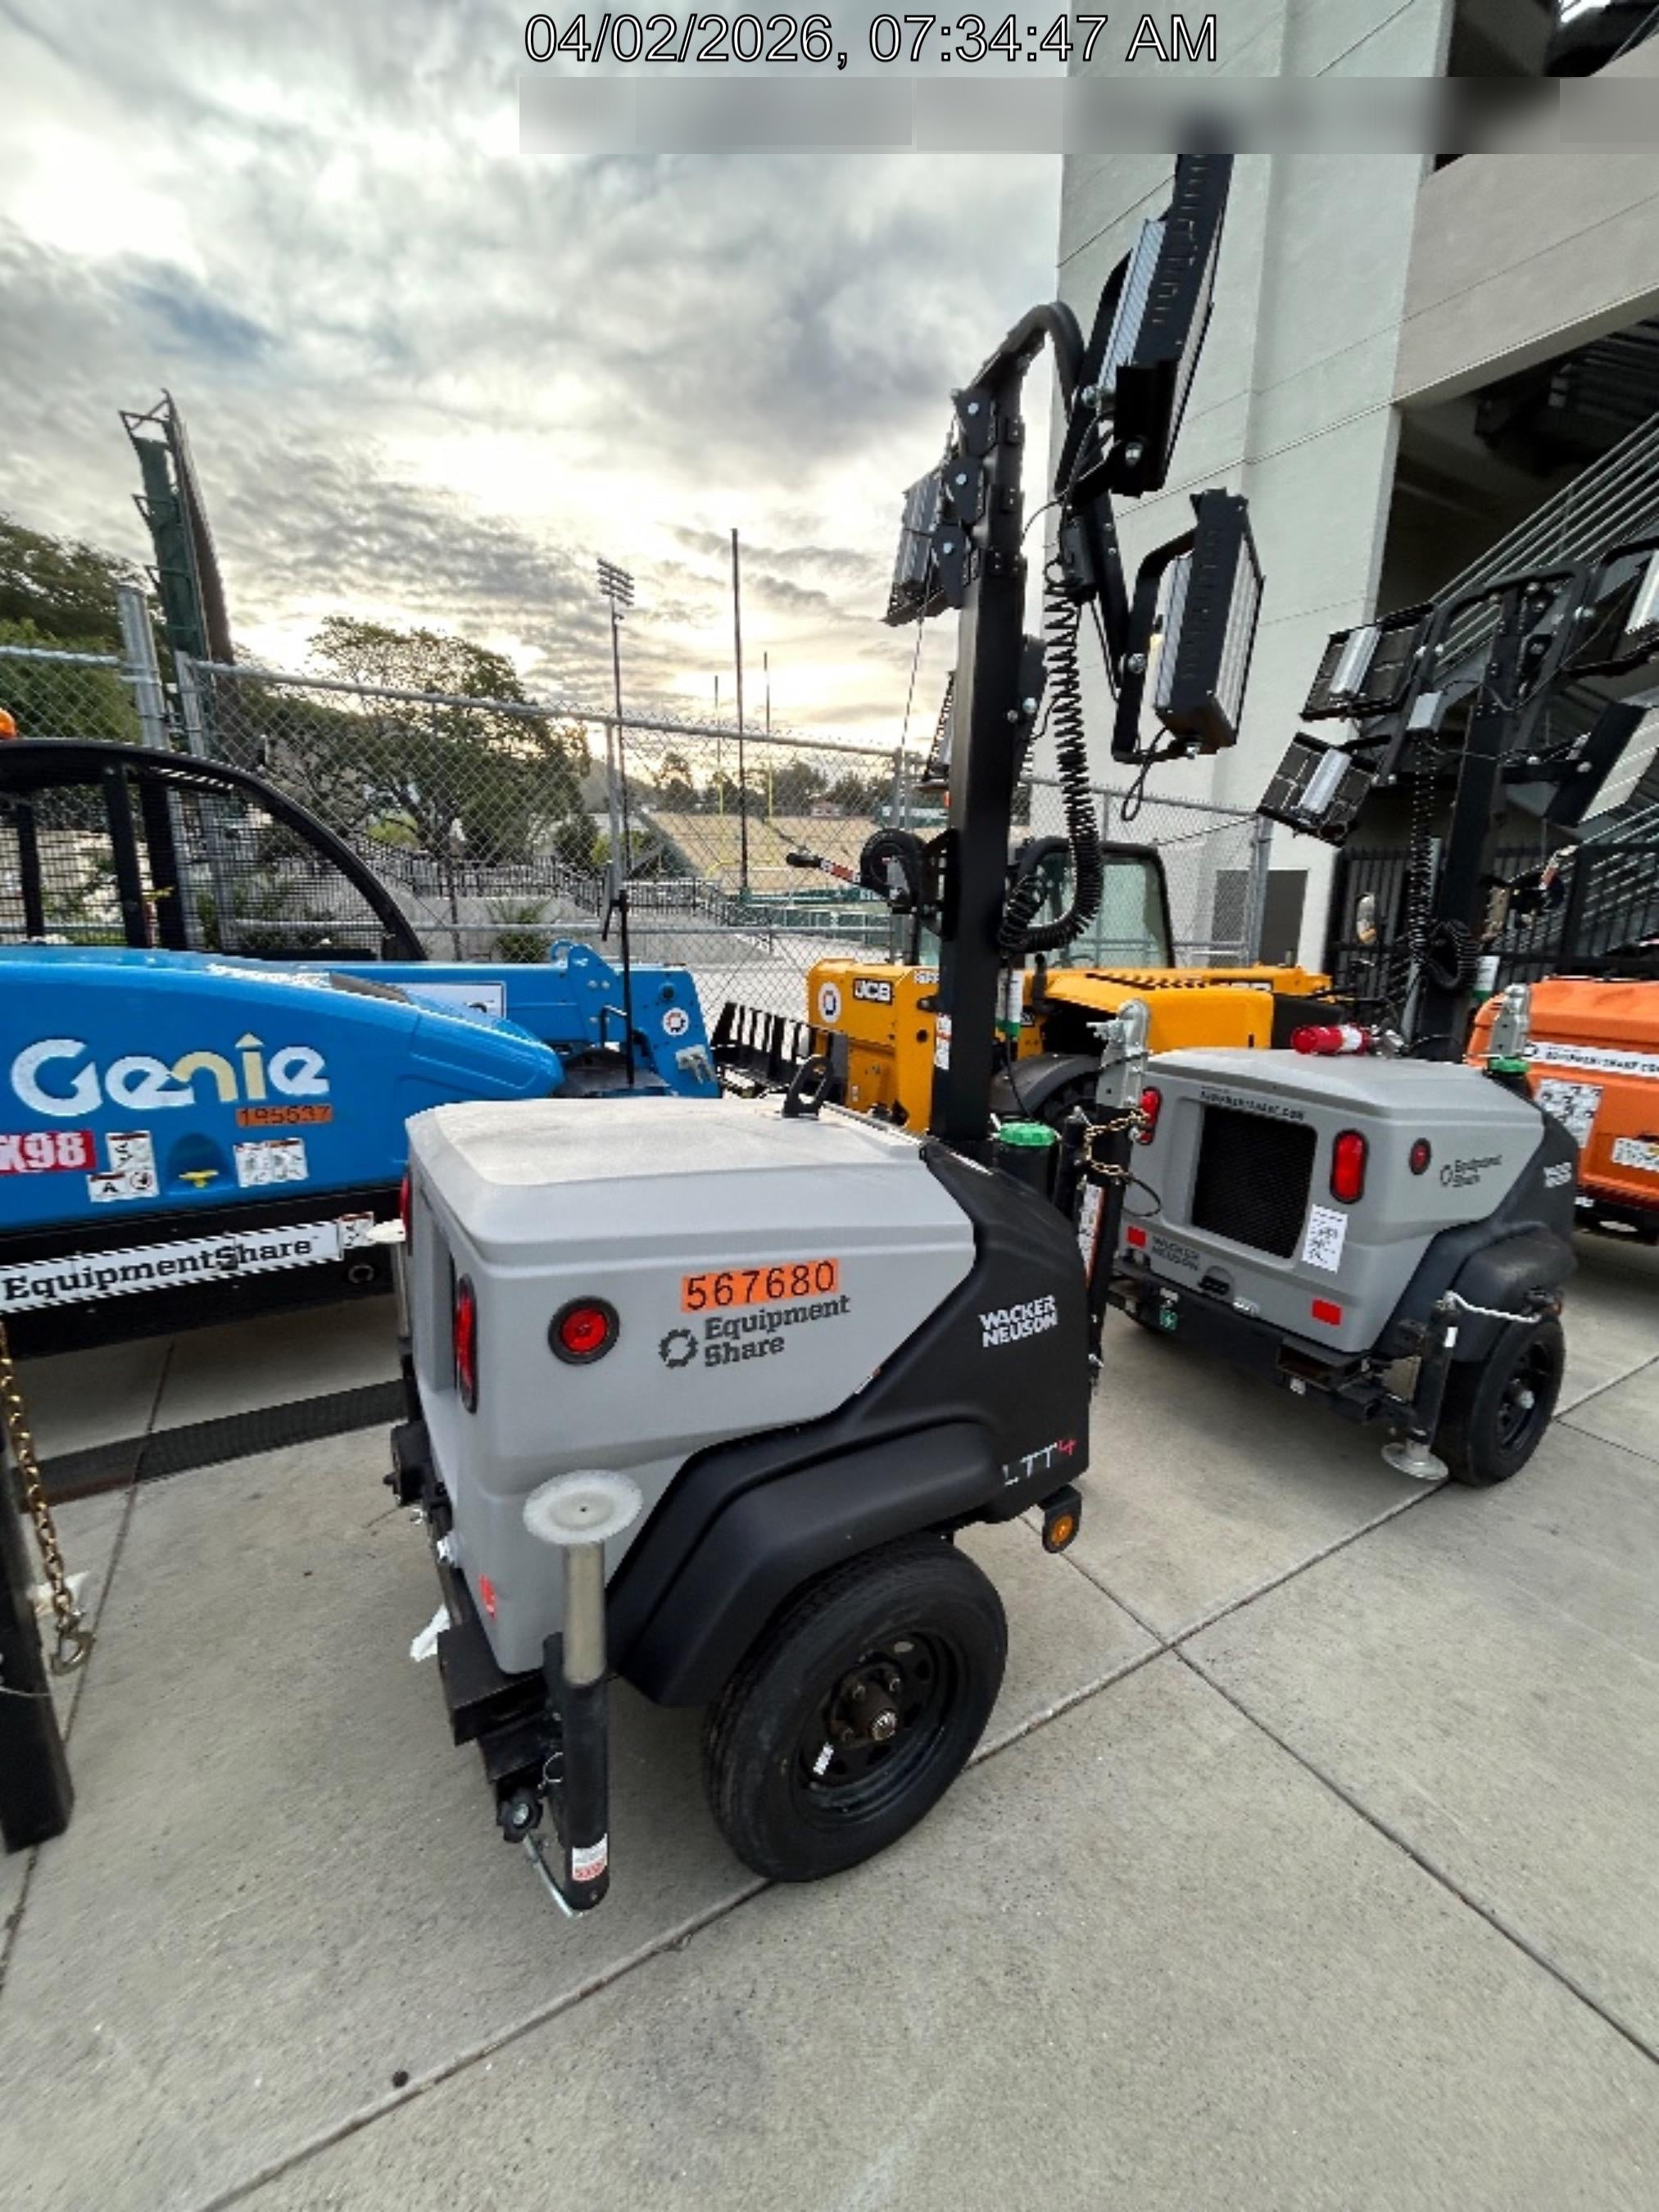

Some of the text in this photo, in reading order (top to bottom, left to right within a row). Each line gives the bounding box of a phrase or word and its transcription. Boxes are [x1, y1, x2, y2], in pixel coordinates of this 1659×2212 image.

[854, 979, 891, 1002] JCB
[11, 1031, 329, 1117] Genie
[2, 1235, 312, 1301] EquipmentShare
[687, 1260, 834, 1311] 567680
[705, 1294, 851, 1341] Equipment
[977, 1294, 1056, 1331] WACKER
[982, 1311, 1058, 1349] NEUSON
[705, 1335, 785, 1367] Share
[1002, 1439, 1076, 1487] LTT4
